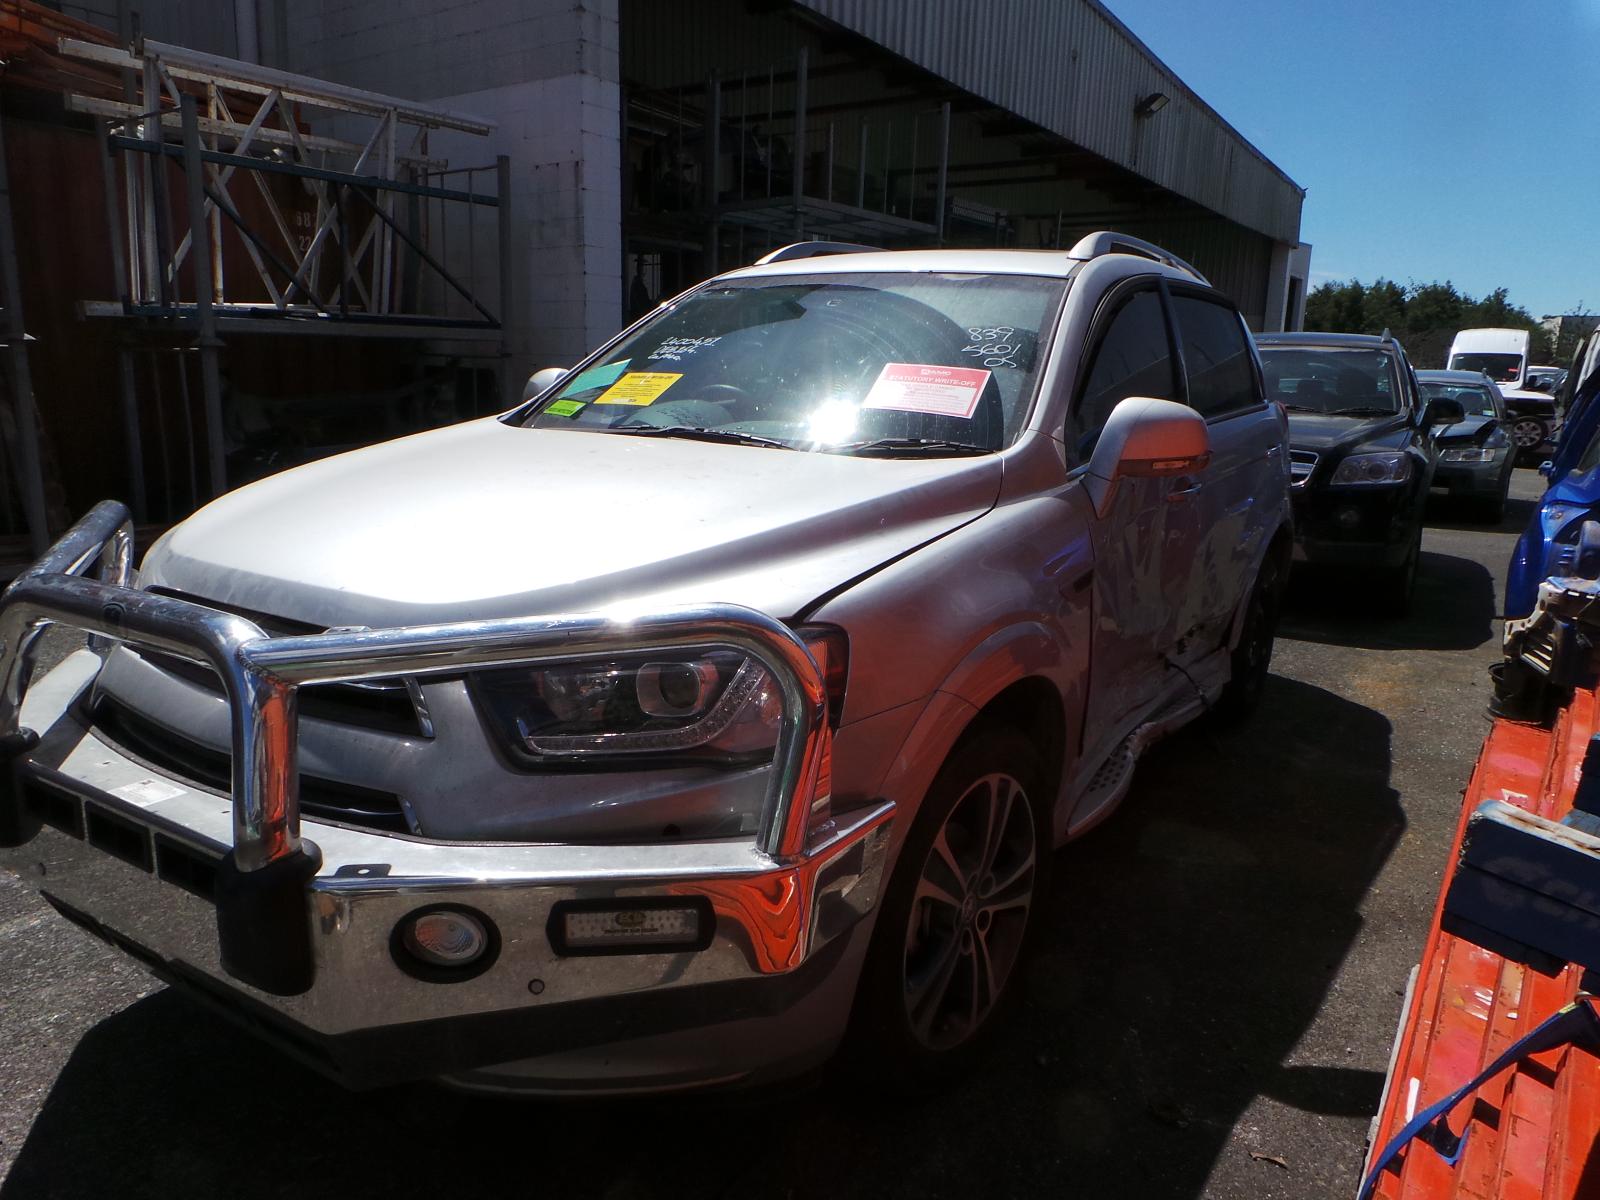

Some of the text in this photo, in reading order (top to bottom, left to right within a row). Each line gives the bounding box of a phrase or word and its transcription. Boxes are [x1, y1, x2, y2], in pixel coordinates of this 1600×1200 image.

[968, 327, 1014, 341] 839
[961, 344, 1021, 356] 5601
[891, 375, 977, 387] STATUTORY WRITE-OFF
